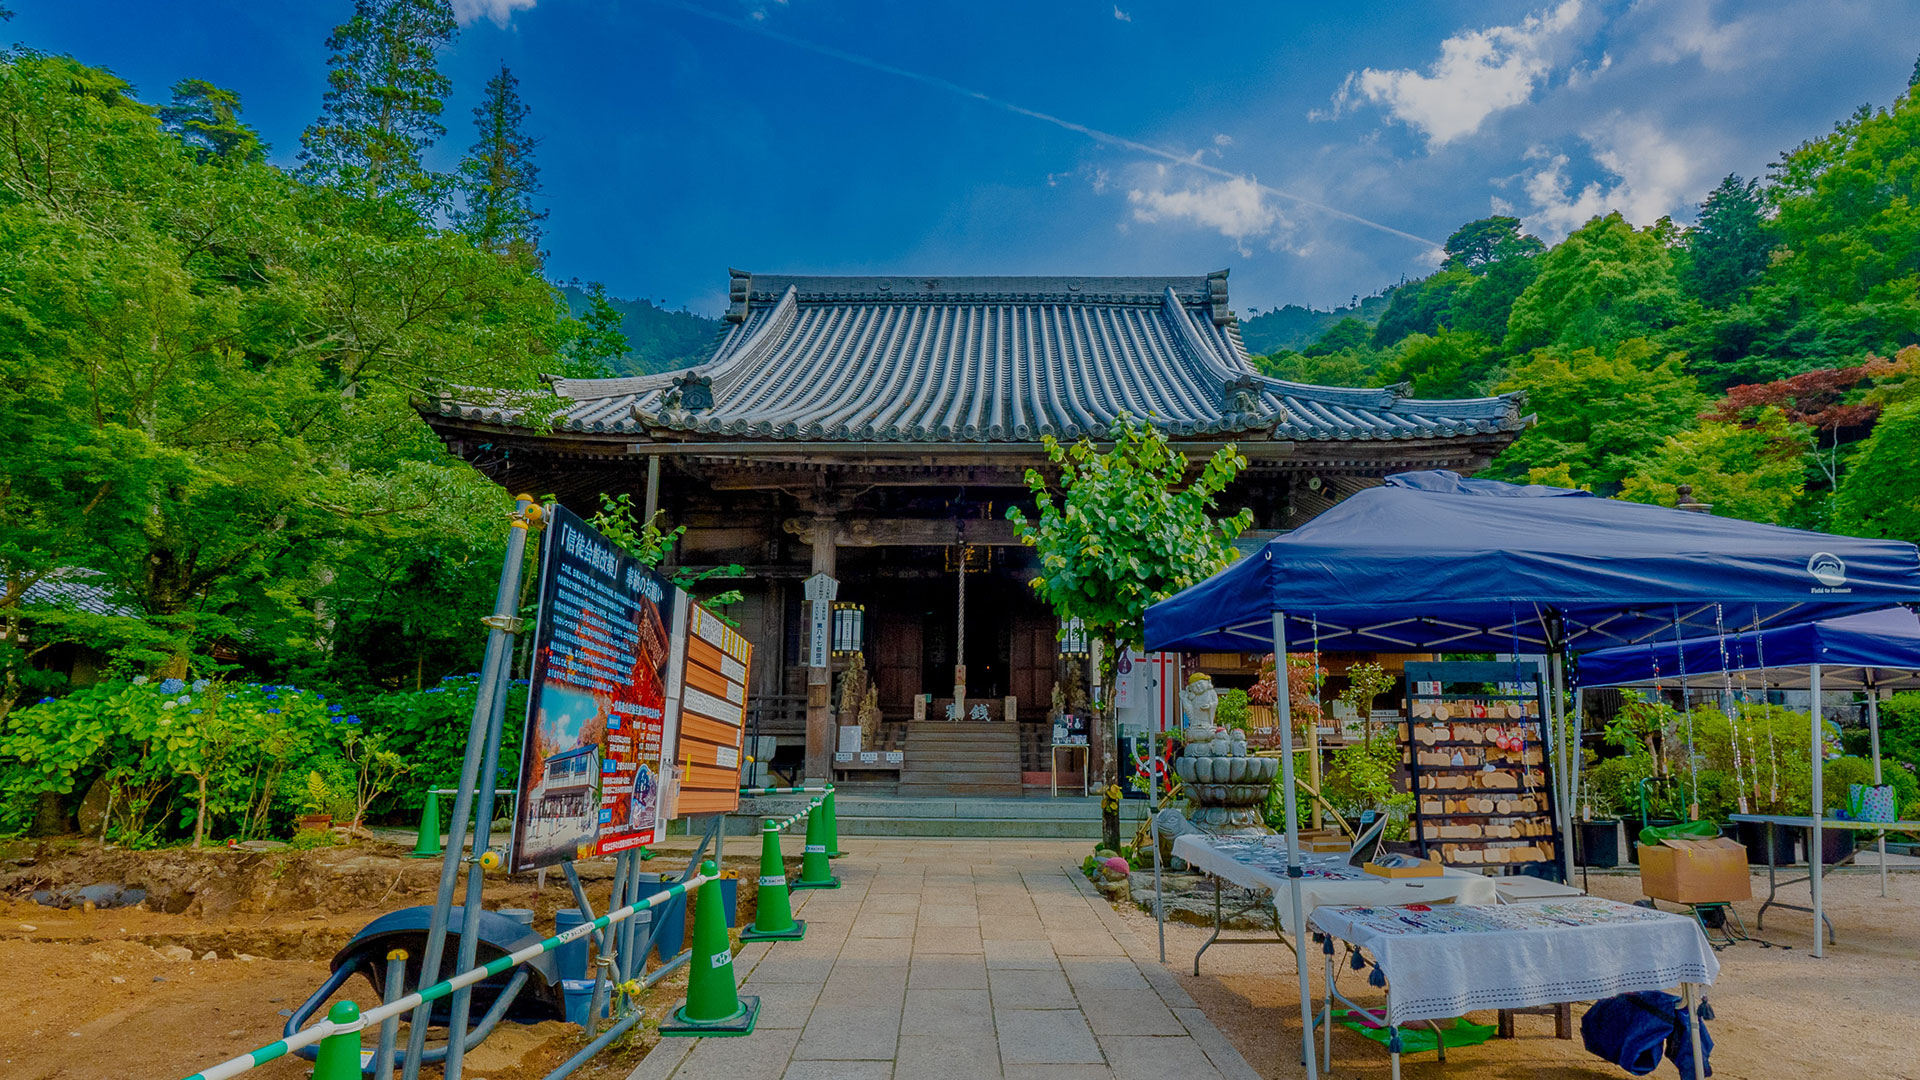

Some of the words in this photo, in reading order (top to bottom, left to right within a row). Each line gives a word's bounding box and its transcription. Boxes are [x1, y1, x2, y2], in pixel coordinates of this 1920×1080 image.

[561, 522, 619, 579] 「信徒会館改築」
[626, 566, 663, 603] 奉納のお願い
